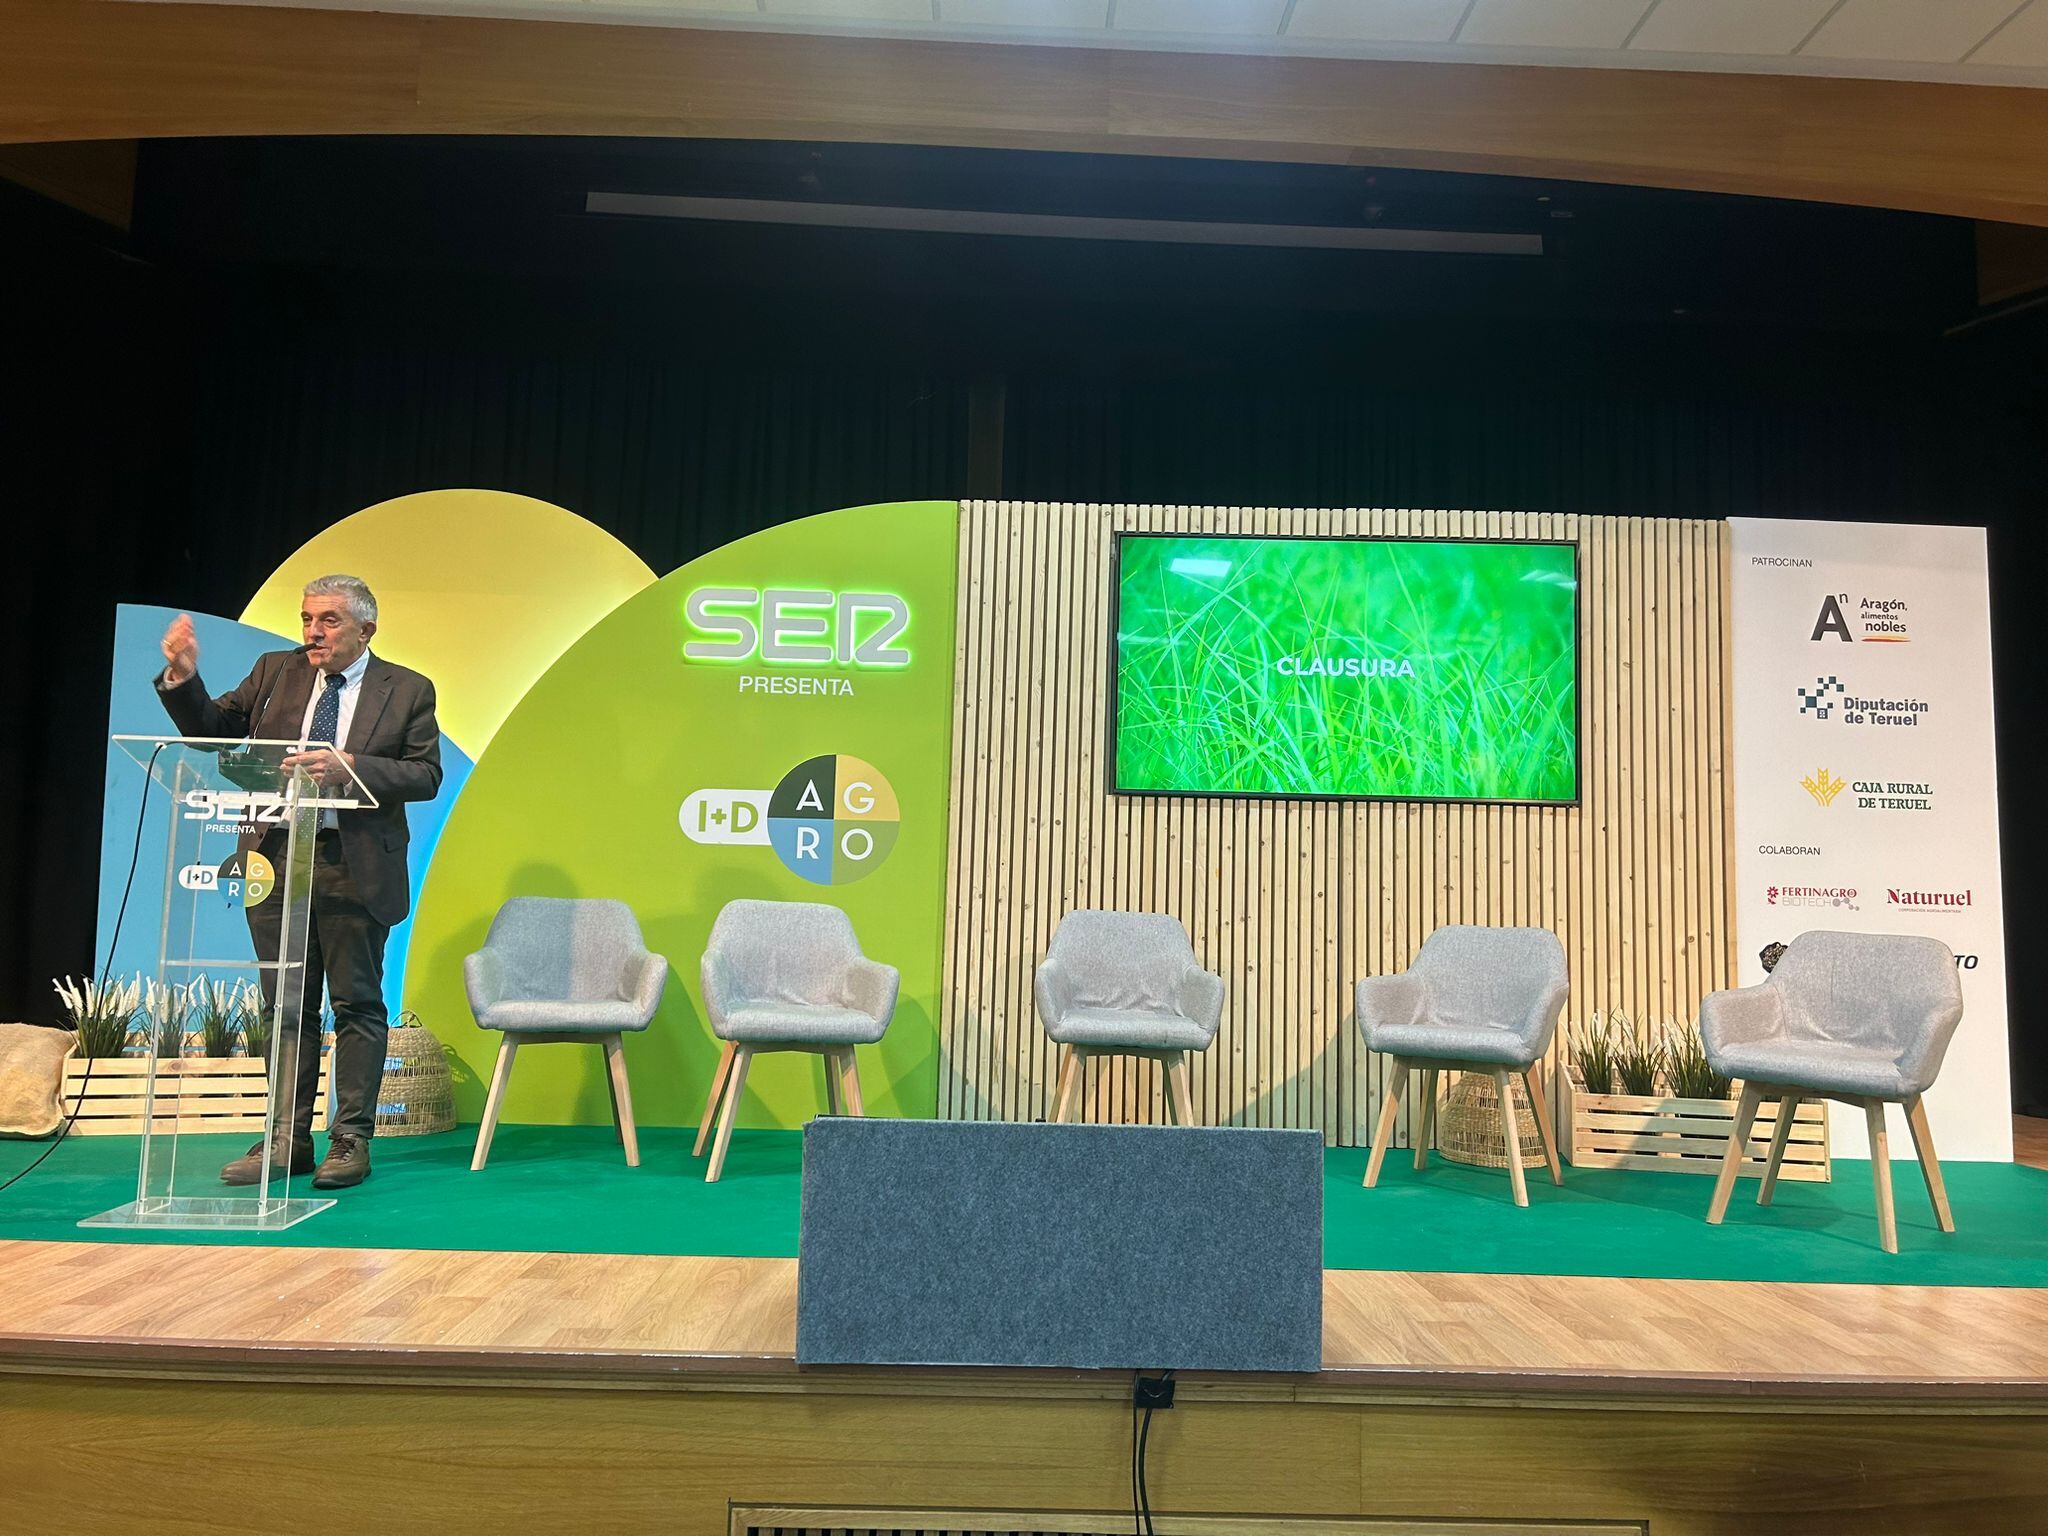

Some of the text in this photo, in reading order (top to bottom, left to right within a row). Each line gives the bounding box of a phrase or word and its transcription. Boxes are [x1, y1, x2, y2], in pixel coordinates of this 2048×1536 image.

[1752, 557, 1813, 568] PATROCINAN
[1860, 597, 1908, 613] Aragón,
[1861, 612, 1898, 620] alimentos
[684, 588, 910, 663] SER
[1865, 621, 1906, 633] nobles
[1276, 656, 1416, 678] CLAUSURA
[739, 676, 854, 696] PRESENTA
[1844, 697, 1929, 713] Diputación
[1845, 711, 1918, 726] de Teruel
[1852, 782, 1933, 795] CAJA RURAL
[1858, 798, 1931, 811] DE TERUEL
[697, 800, 759, 833] I+D
[205, 823, 256, 834] PRESENTA
[1758, 845, 1821, 855] COLABORAN
[186, 870, 214, 885] I+D
[1782, 886, 1857, 898] FERTINAGRO
[1887, 888, 1972, 906] Naturuel
[1782, 897, 1832, 907] BIOTECH
